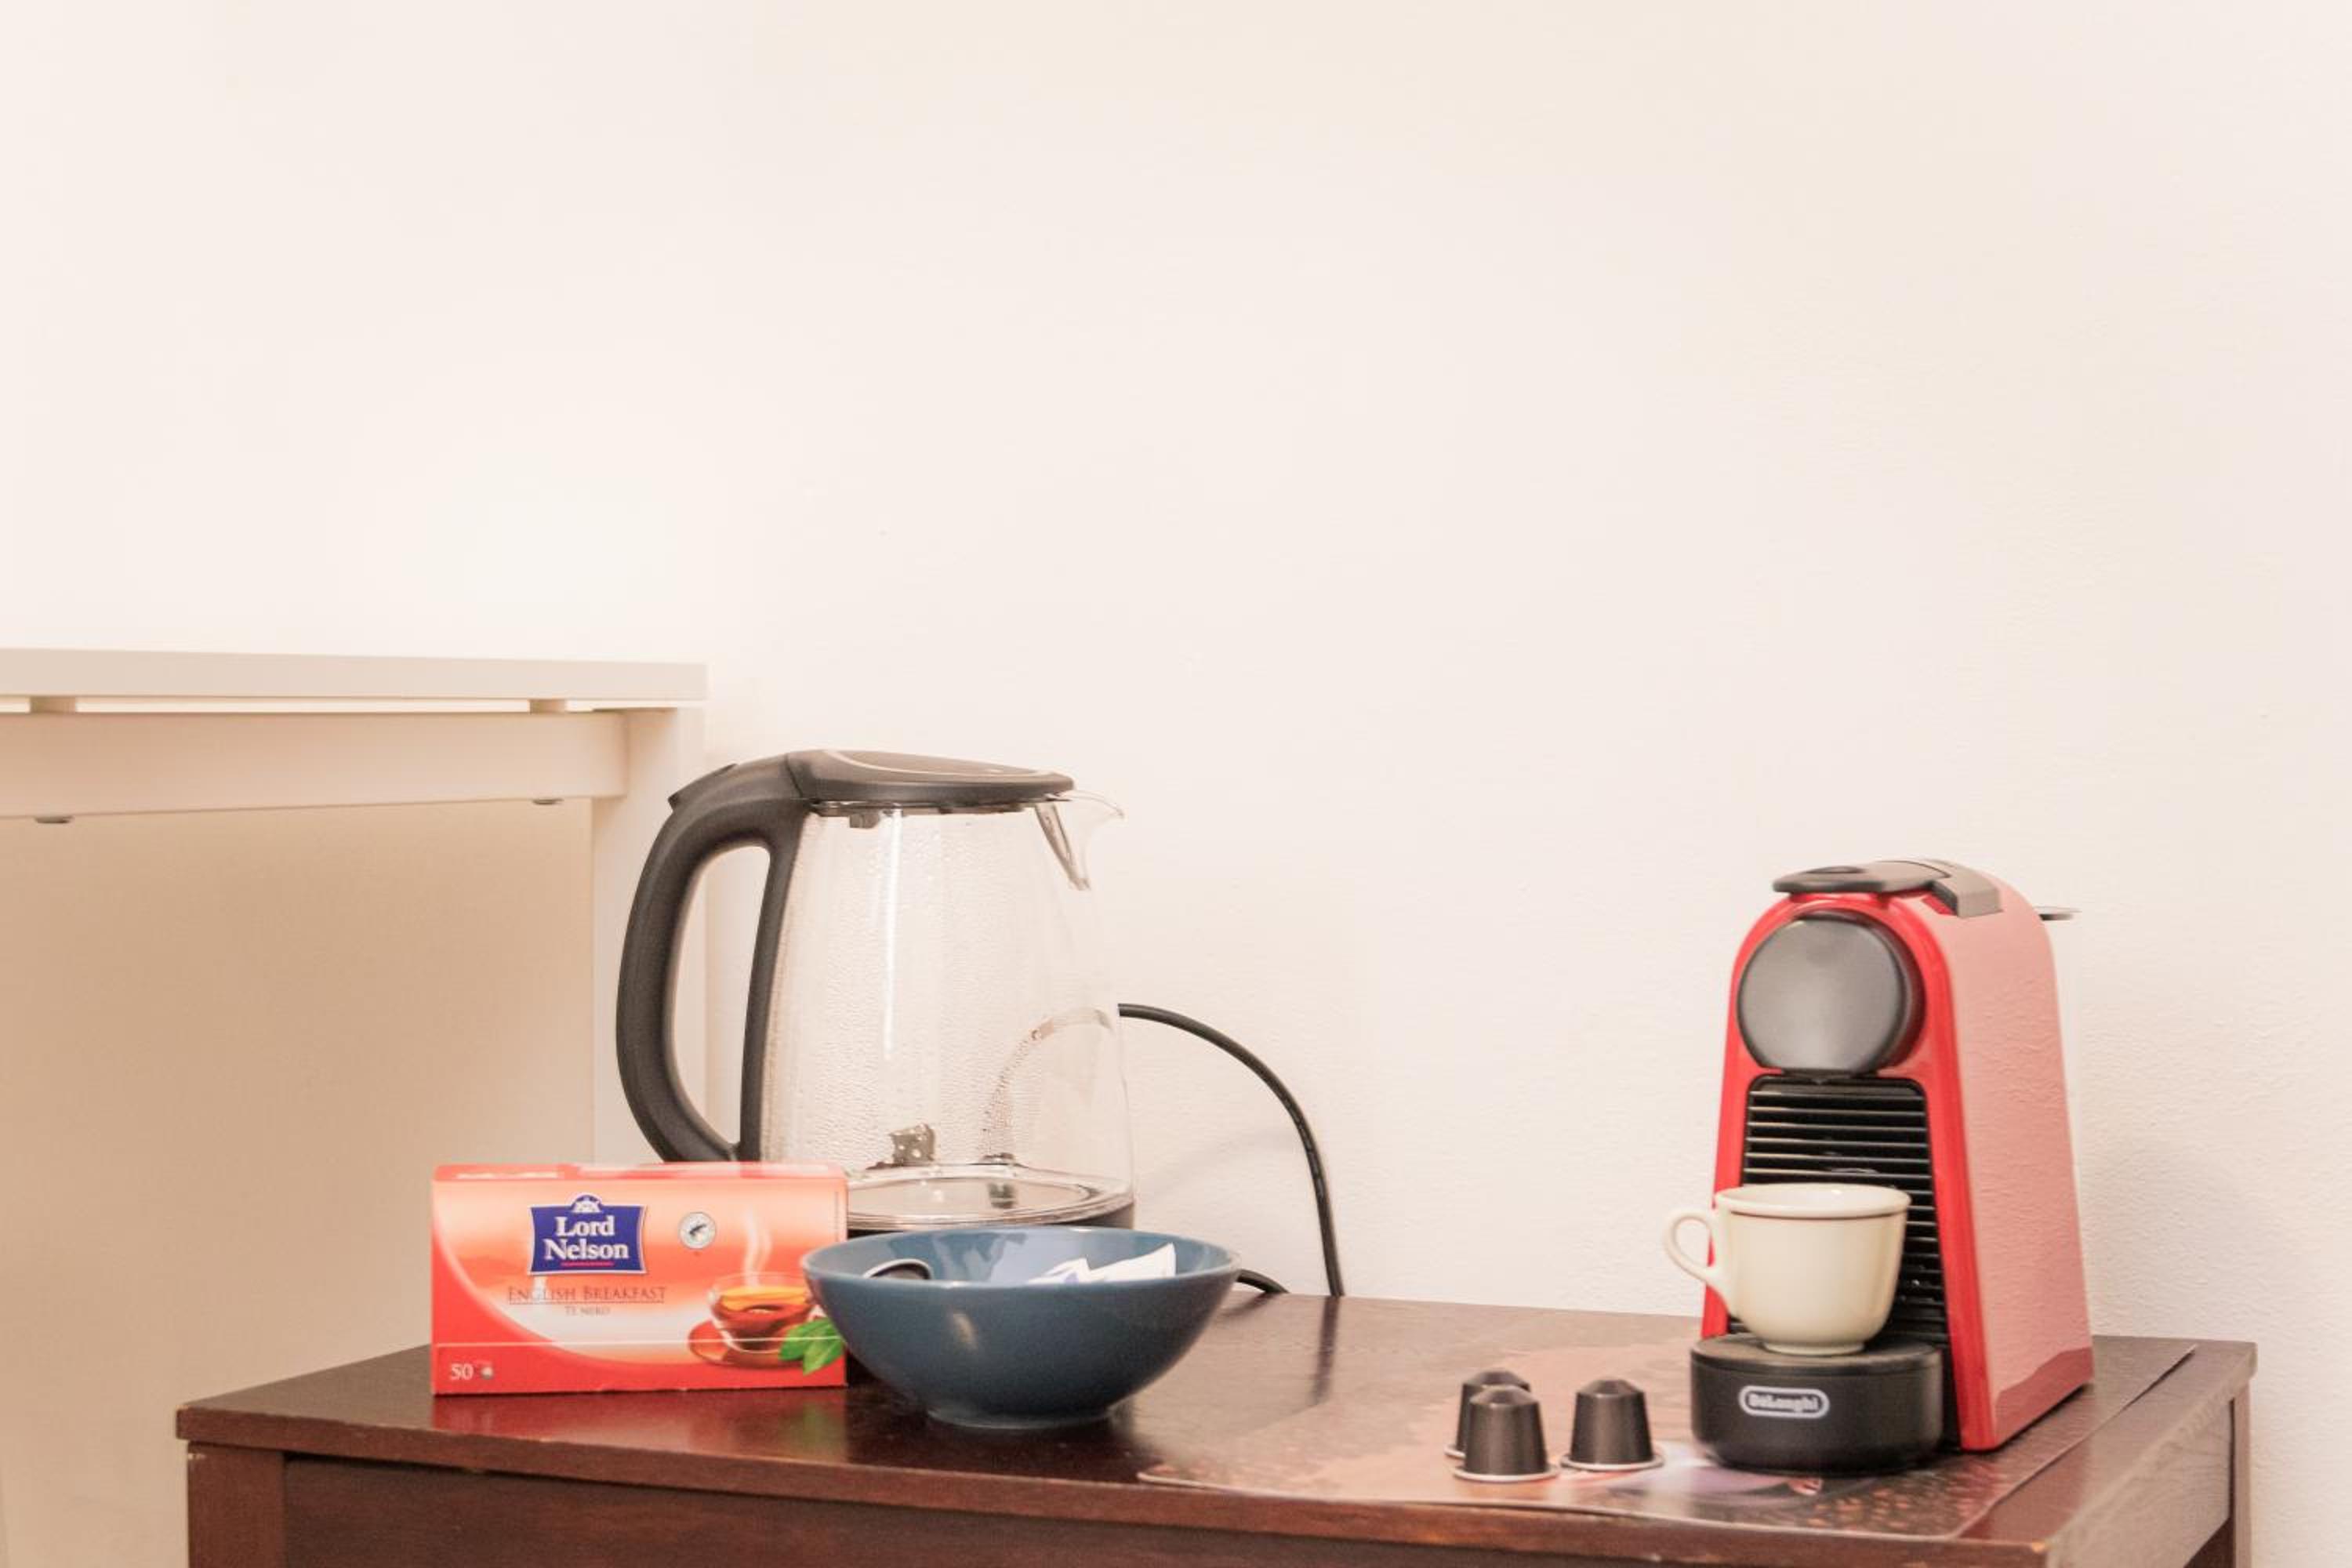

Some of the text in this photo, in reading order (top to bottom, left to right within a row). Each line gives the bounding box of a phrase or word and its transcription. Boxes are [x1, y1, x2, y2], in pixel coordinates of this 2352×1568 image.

[556, 1215, 615, 1236] Lord
[543, 1238, 629, 1260] Nelson
[509, 1286, 666, 1301] ENGLISH BREAKFAST
[451, 1363, 474, 1380] 50
